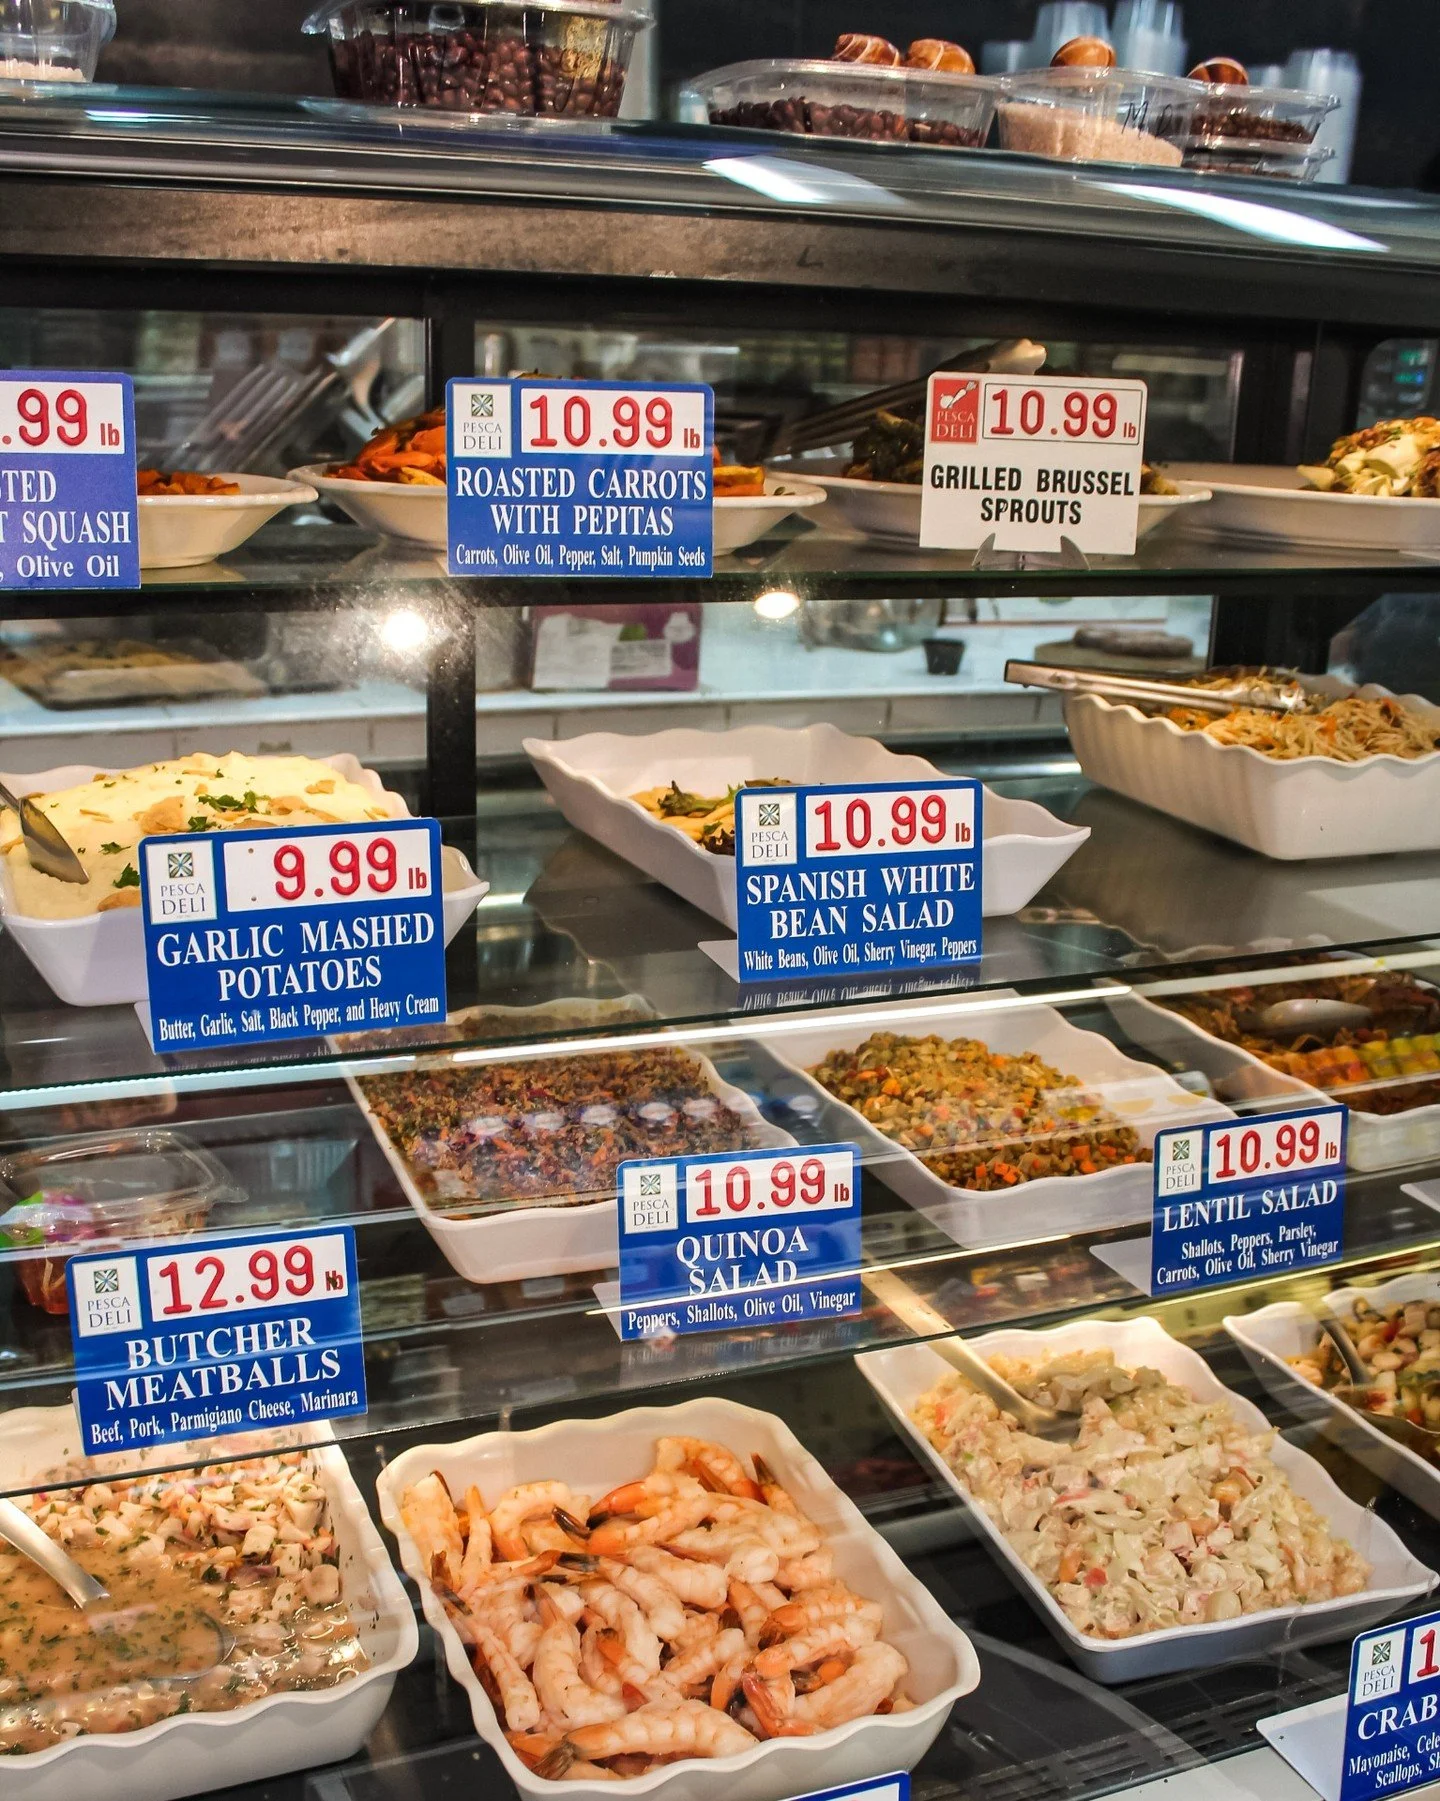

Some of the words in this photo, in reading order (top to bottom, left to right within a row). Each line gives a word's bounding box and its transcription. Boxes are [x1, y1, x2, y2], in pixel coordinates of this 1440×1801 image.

[463, 422, 502, 433] PESCA
[530, 395, 673, 448] 10.99
[684, 428, 701, 449] lb
[937, 411, 975, 423] PESCA
[991, 389, 1118, 438] 10.99
[1123, 422, 1136, 438] lb
[100, 423, 120, 446] lb
[463, 435, 501, 450] DELI
[936, 424, 973, 438] DELI
[0, 470, 57, 503] TED
[456, 467, 575, 498] ROASTED
[588, 469, 706, 500] CARROTS
[931, 464, 1022, 491] GRILLED
[1037, 468, 1134, 496] BRUSSEL
[490, 504, 560, 534] WITH
[573, 505, 674, 536] PEPITAS
[981, 497, 1082, 525] SPROUTS
[22, 511, 131, 550] SQUASH
[17, 555, 74, 578] Olive
[87, 555, 120, 578] Oil
[456, 543, 498, 566] Carrots,
[504, 544, 530, 565] Olive
[535, 544, 554, 567] Oil,
[559, 545, 596, 570] Pepper,
[601, 545, 623, 568] Salt,
[629, 546, 673, 571] Pumpkin
[678, 546, 705, 567] Seeds
[751, 831, 788, 843] PESCA
[815, 795, 947, 851] 10.99
[955, 823, 971, 842] lb
[752, 843, 788, 859] DELI
[273, 837, 397, 900] 9.99
[408, 868, 427, 890] lb
[747, 869, 867, 905] SPANISH
[881, 863, 975, 896] WHITE
[160, 883, 206, 898] PESCA
[161, 897, 206, 915] DELI
[770, 906, 848, 940] BEAN
[862, 899, 954, 933] SALAD
[157, 924, 284, 967] GARLIC
[300, 912, 434, 954] MASHED
[744, 950, 773, 971] White
[778, 948, 809, 970] Beans,
[814, 946, 838, 966] Olive
[843, 943, 860, 966] Oil,
[864, 941, 896, 965] Sherry
[900, 939, 937, 963] Vinegar,
[941, 937, 977, 959] Peppers
[218, 956, 382, 1001] POTATOES
[159, 1018, 196, 1041] Butter,
[200, 1014, 237, 1037] Garlic,
[241, 1010, 265, 1033] Salt,
[270, 1006, 299, 1029] Black
[304, 1004, 341, 1030] Pepper,
[346, 999, 365, 1022] and
[370, 997, 401, 1022] Heavy
[406, 994, 439, 1015] Cream
[1216, 1120, 1320, 1179] 10.99
[1325, 1141, 1338, 1159] lb
[1166, 1163, 1195, 1175] PESCA
[1166, 1174, 1195, 1190] DELI
[695, 1158, 826, 1216] 10.99
[834, 1184, 849, 1203] lb
[633, 1199, 669, 1212] PESCA
[633, 1211, 670, 1226] DELI
[1162, 1194, 1250, 1232] LENTIL
[1262, 1179, 1338, 1215] SALAD
[676, 1226, 809, 1269] QUINOA
[1181, 1238, 1225, 1260] Shallots,
[1230, 1230, 1273, 1253] Peppers,
[1279, 1222, 1317, 1244] Parsley,
[689, 1259, 798, 1296] SALAD
[1157, 1263, 1200, 1285] Carrots,
[1205, 1256, 1233, 1276] Olive
[1238, 1250, 1257, 1270] Oil,
[1261, 1246, 1296, 1266] Sherry
[1300, 1239, 1339, 1260] Vinegar
[159, 1245, 315, 1315] 12.99
[87, 1297, 131, 1312] PESCA
[89, 1310, 131, 1329] DELI
[628, 1310, 681, 1334] Peppers,
[687, 1303, 738, 1325] Shallots,
[744, 1298, 776, 1317] Olive
[781, 1293, 804, 1315] Oil,
[809, 1290, 855, 1312] Vinegar
[125, 1317, 316, 1372] BUTCHER
[104, 1350, 341, 1411] MEATBALLS
[91, 1423, 123, 1446] Beef,
[130, 1417, 165, 1440] Pork,
[171, 1406, 242, 1433] Parmigiano
[248, 1399, 295, 1421] Cheese,
[301, 1389, 358, 1413] Marinara
[1416, 1629, 1439, 1678] 1
[1363, 1676, 1394, 1696] DELI
[1364, 1665, 1395, 1682] PESCA
[1358, 1694, 1438, 1740] CRAB
[1348, 1743, 1410, 1777] Mayonaise,
[1375, 1763, 1423, 1789] Scallops,
